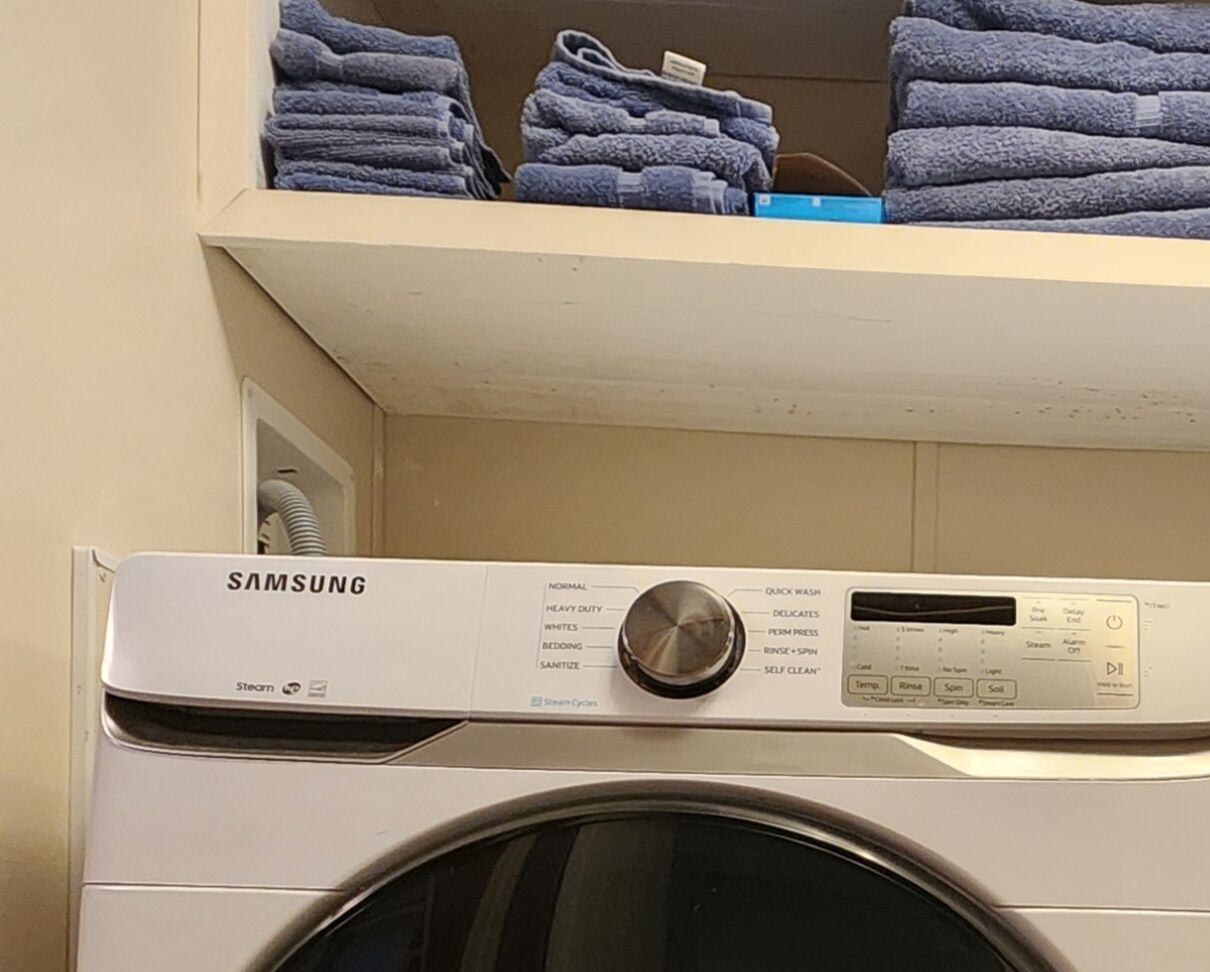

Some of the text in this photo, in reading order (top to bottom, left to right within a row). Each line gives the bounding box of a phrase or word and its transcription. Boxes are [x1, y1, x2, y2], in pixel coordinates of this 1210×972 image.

[227, 572, 366, 594] SAMSUNG
[548, 582, 588, 590] NORMAL
[765, 587, 821, 596] QUICK WASH
[546, 604, 602, 613] HEAVY DUTY
[773, 610, 820, 618] DELICATES
[544, 623, 578, 631] WHITES
[768, 628, 792, 636] PERM
[542, 642, 583, 650] BEDDING
[1025, 640, 1051, 648] Steam
[763, 647, 790, 655] RINSE
[540, 661, 580, 670] SANITIZE
[764, 666, 786, 674] SELF
[236, 681, 275, 692] Steam
[899, 681, 923, 690] Rinse
[944, 683, 964, 692] Spin
[988, 684, 1005, 693] Soil
[544, 698, 598, 707] Steam Cycles
